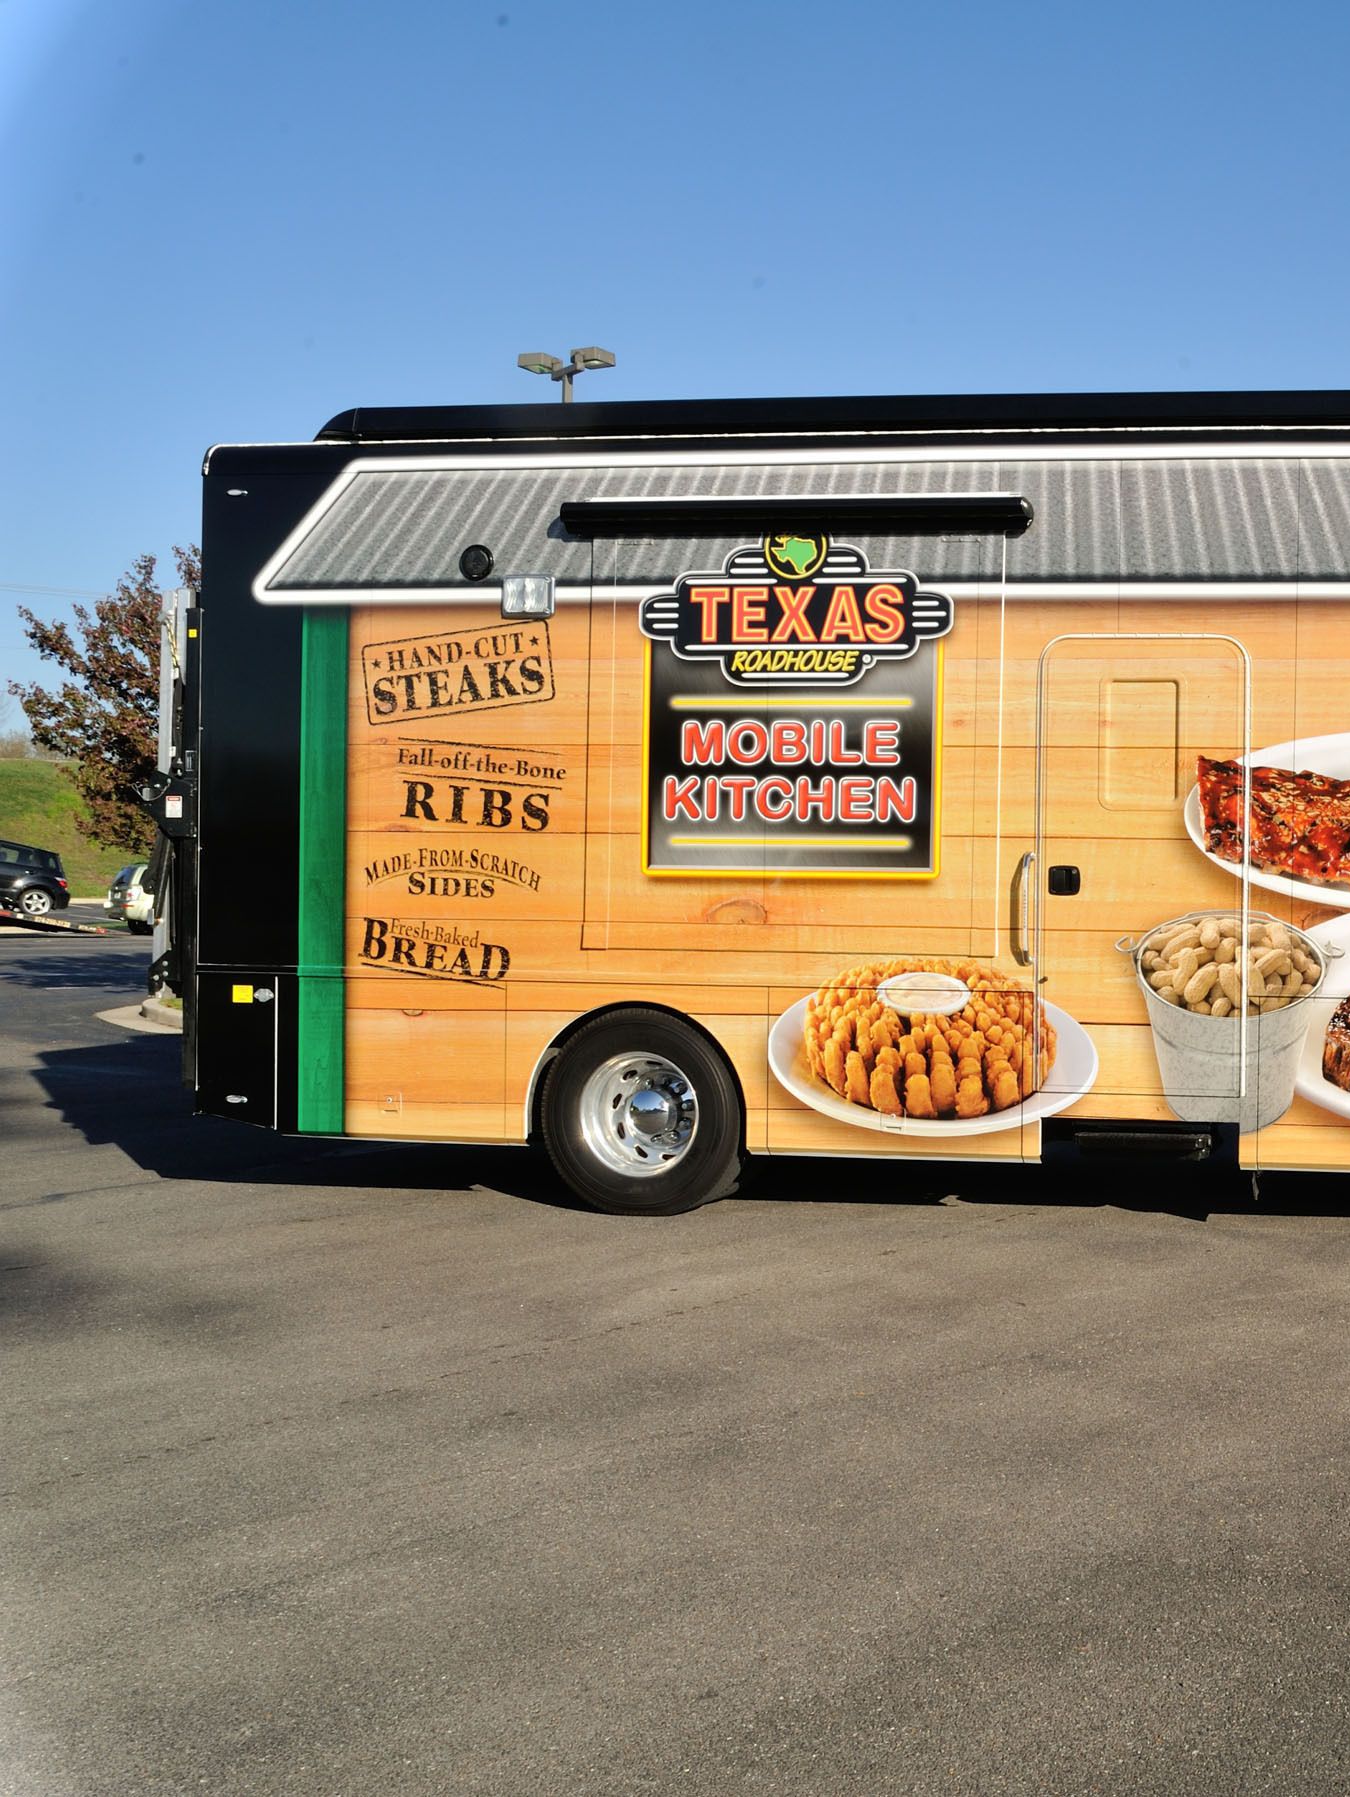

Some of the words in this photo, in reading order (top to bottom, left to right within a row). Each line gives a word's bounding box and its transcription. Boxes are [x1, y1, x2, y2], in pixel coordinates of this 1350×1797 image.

[690, 584, 905, 643] TEXAS
[386, 632, 524, 673] HAND-CUT
[731, 650, 859, 672] ROADHOUSE
[373, 655, 545, 716] STEAKS
[398, 748, 567, 781] Fall-off-the-Bone
[682, 720, 900, 766] MOBILE
[400, 780, 550, 832] RIBS
[664, 776, 917, 822] KITCHEN
[408, 871, 495, 898] SIDES
[358, 917, 511, 981] BREAD
[389, 918, 480, 948] Fresh-Baked
